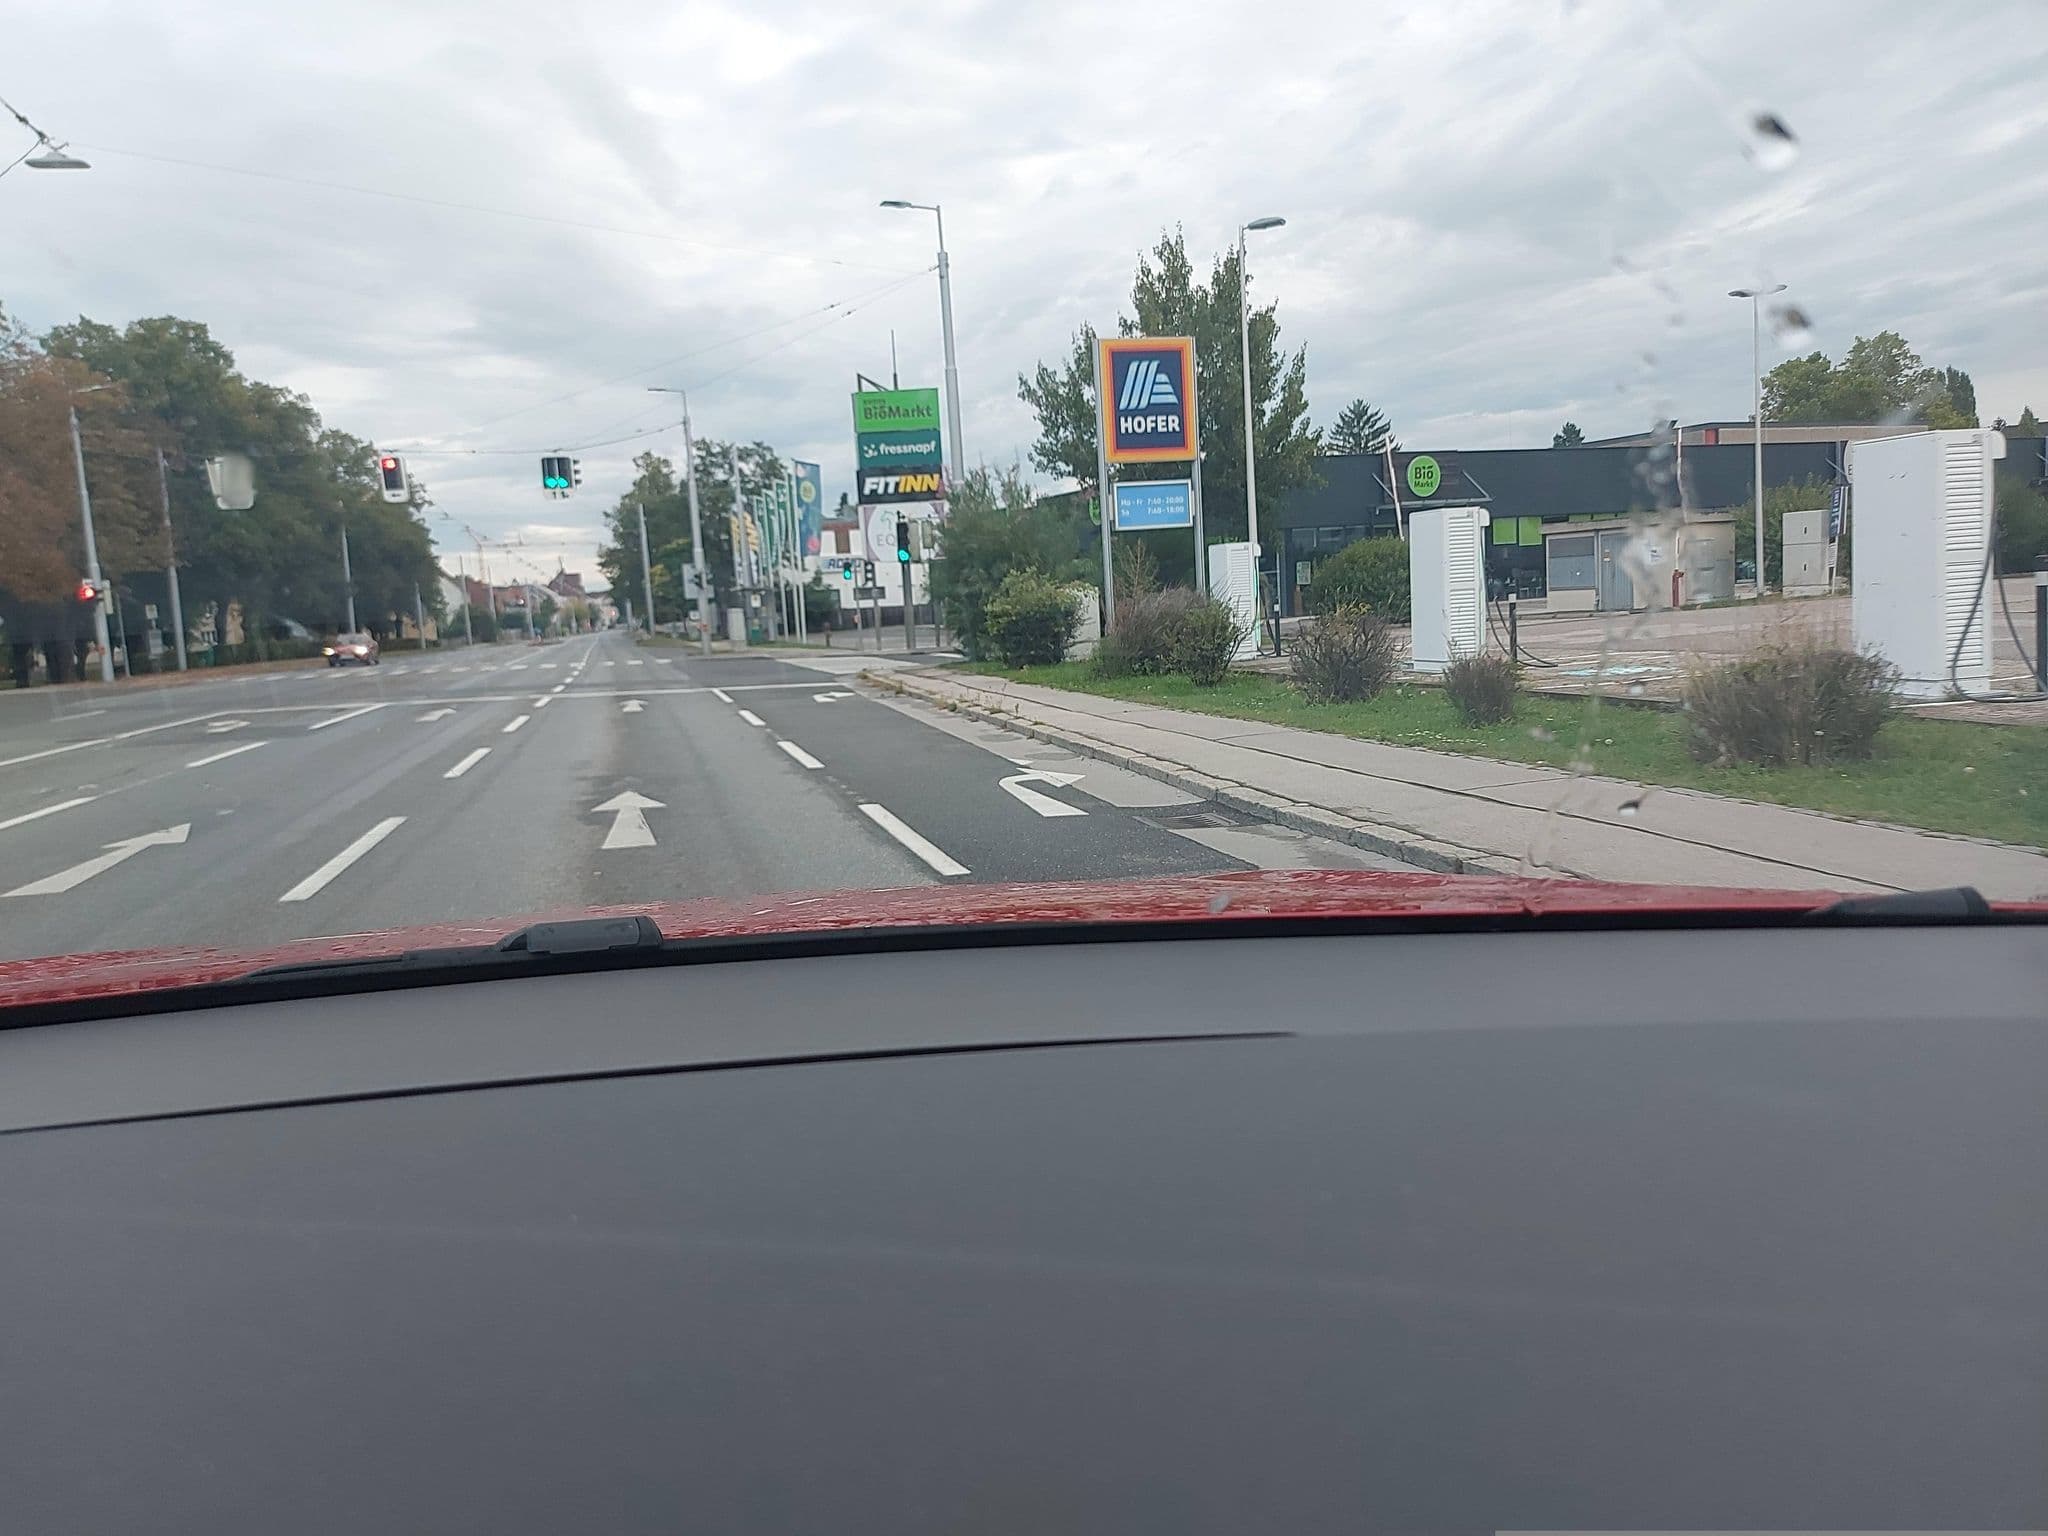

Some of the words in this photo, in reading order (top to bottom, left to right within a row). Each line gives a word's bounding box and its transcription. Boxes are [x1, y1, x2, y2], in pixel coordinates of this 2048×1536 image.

[1120, 415, 1180, 434] HOFER
[879, 440, 936, 455] fressnapf
[1414, 480, 1434, 488] Markt
